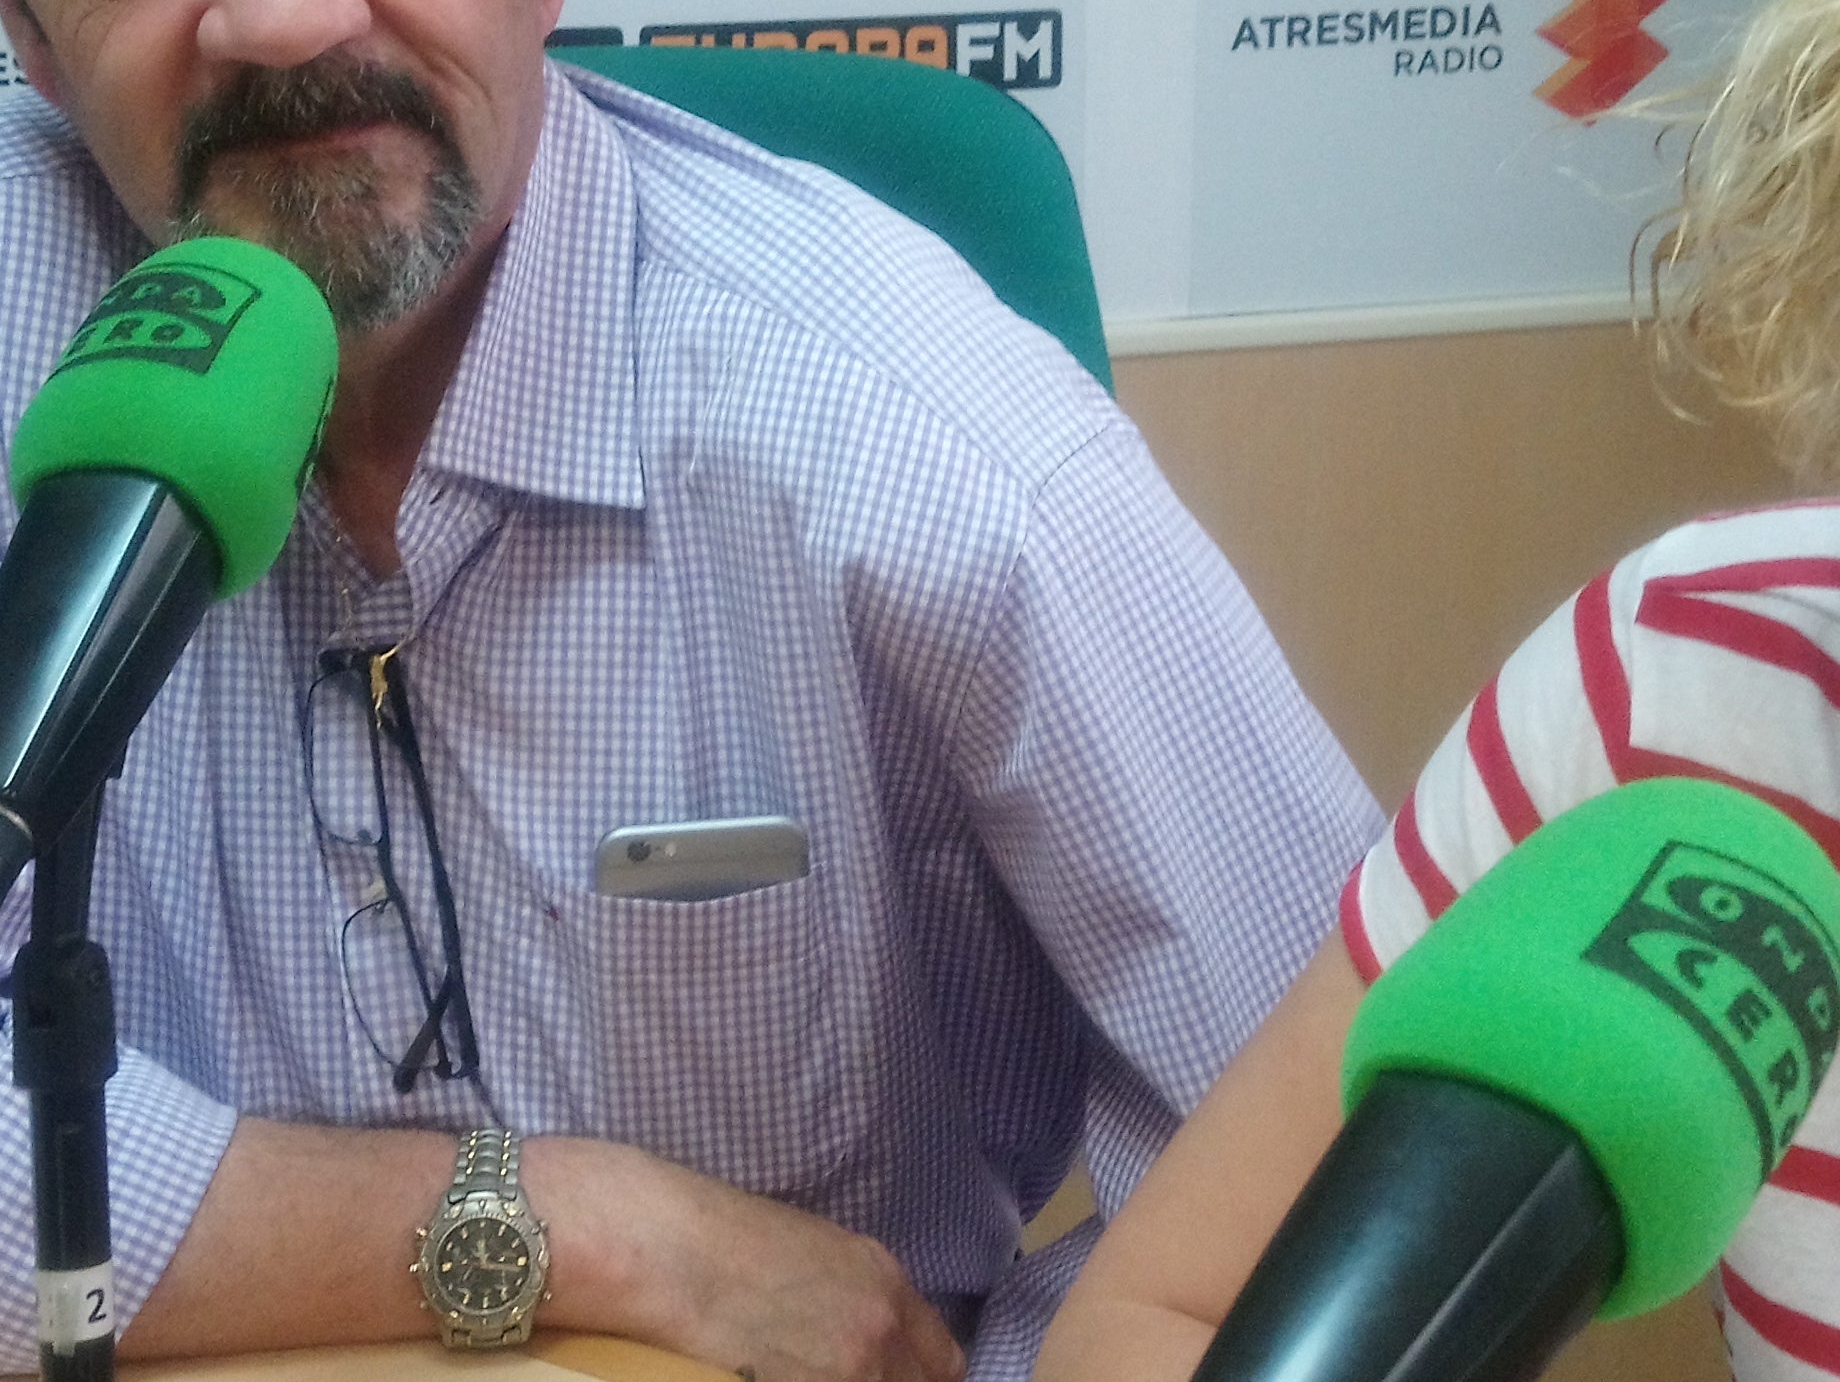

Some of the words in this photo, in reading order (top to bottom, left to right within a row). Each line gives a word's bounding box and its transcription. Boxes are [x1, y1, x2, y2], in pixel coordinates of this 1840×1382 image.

[1231, 3, 1504, 53] ATRESMEDIA
[1392, 45, 1504, 79] RADIO
[1700, 884, 1836, 1065] OND
[85, 1286, 107, 1324] 2
